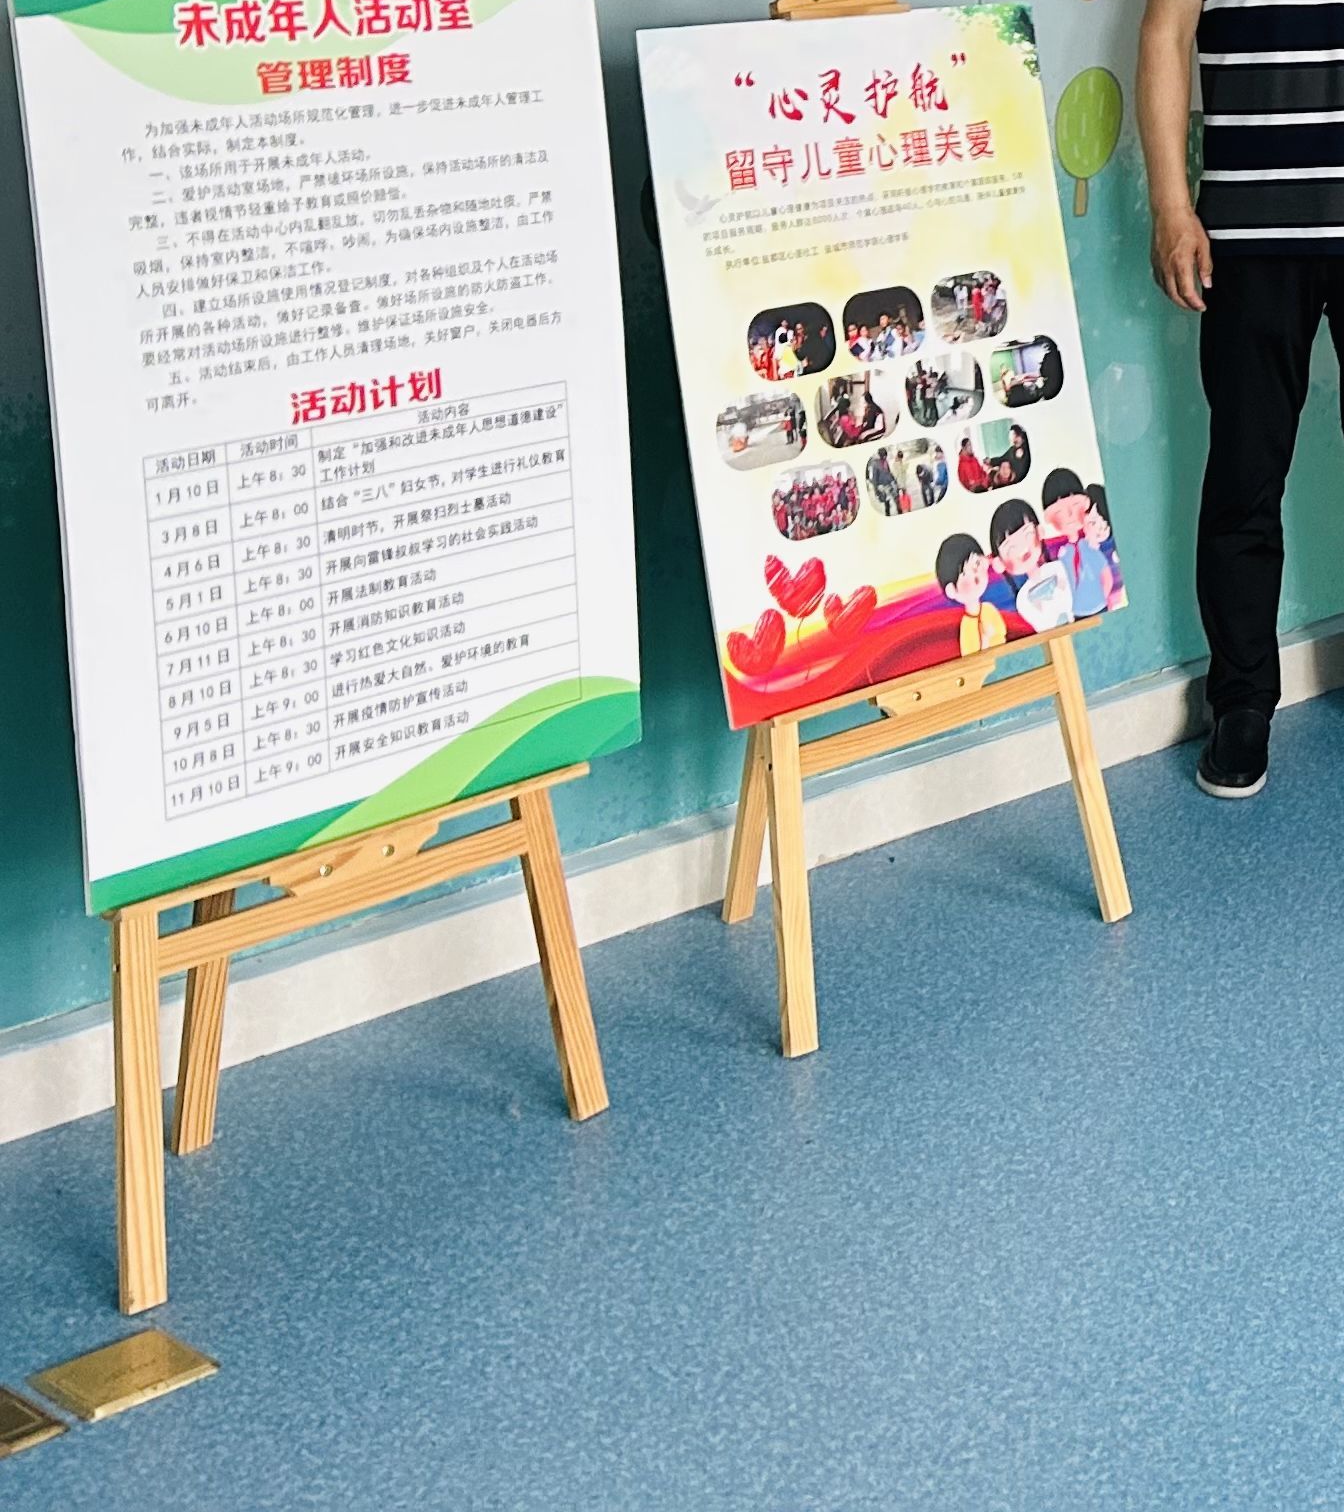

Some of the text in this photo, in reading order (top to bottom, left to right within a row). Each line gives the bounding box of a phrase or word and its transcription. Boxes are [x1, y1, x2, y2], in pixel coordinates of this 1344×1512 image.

[256, 52, 413, 94] 管理制度
[725, 119, 996, 191] 留守儿童心理关爱
[291, 367, 442, 425] 活动计划
[156, 402, 470, 474] 活动日期 活动时间 活动内容
[320, 459, 375, 483] 工作计划
